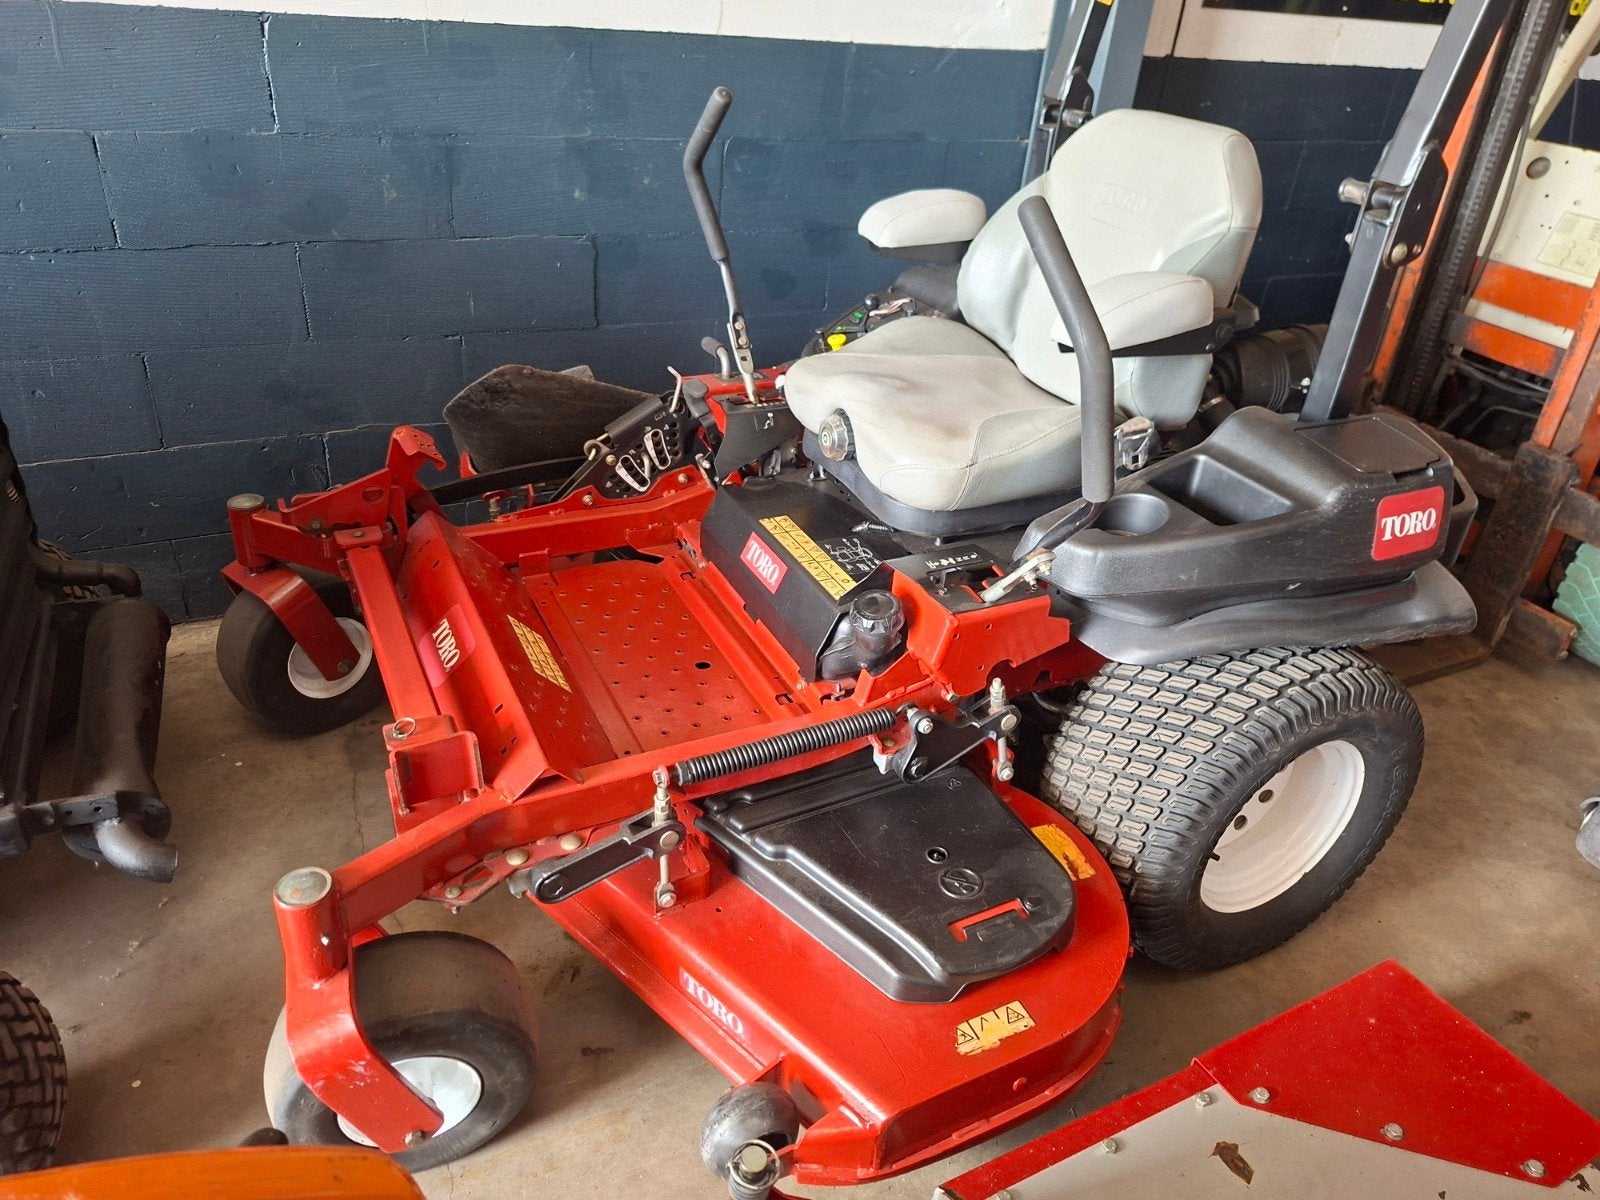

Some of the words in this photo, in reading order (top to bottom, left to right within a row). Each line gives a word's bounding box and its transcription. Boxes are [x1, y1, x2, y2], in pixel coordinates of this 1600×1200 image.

[1381, 508, 1436, 541] TORO
[746, 540, 779, 584] TORO
[432, 618, 460, 668] TORO
[683, 972, 744, 1034] TORO
